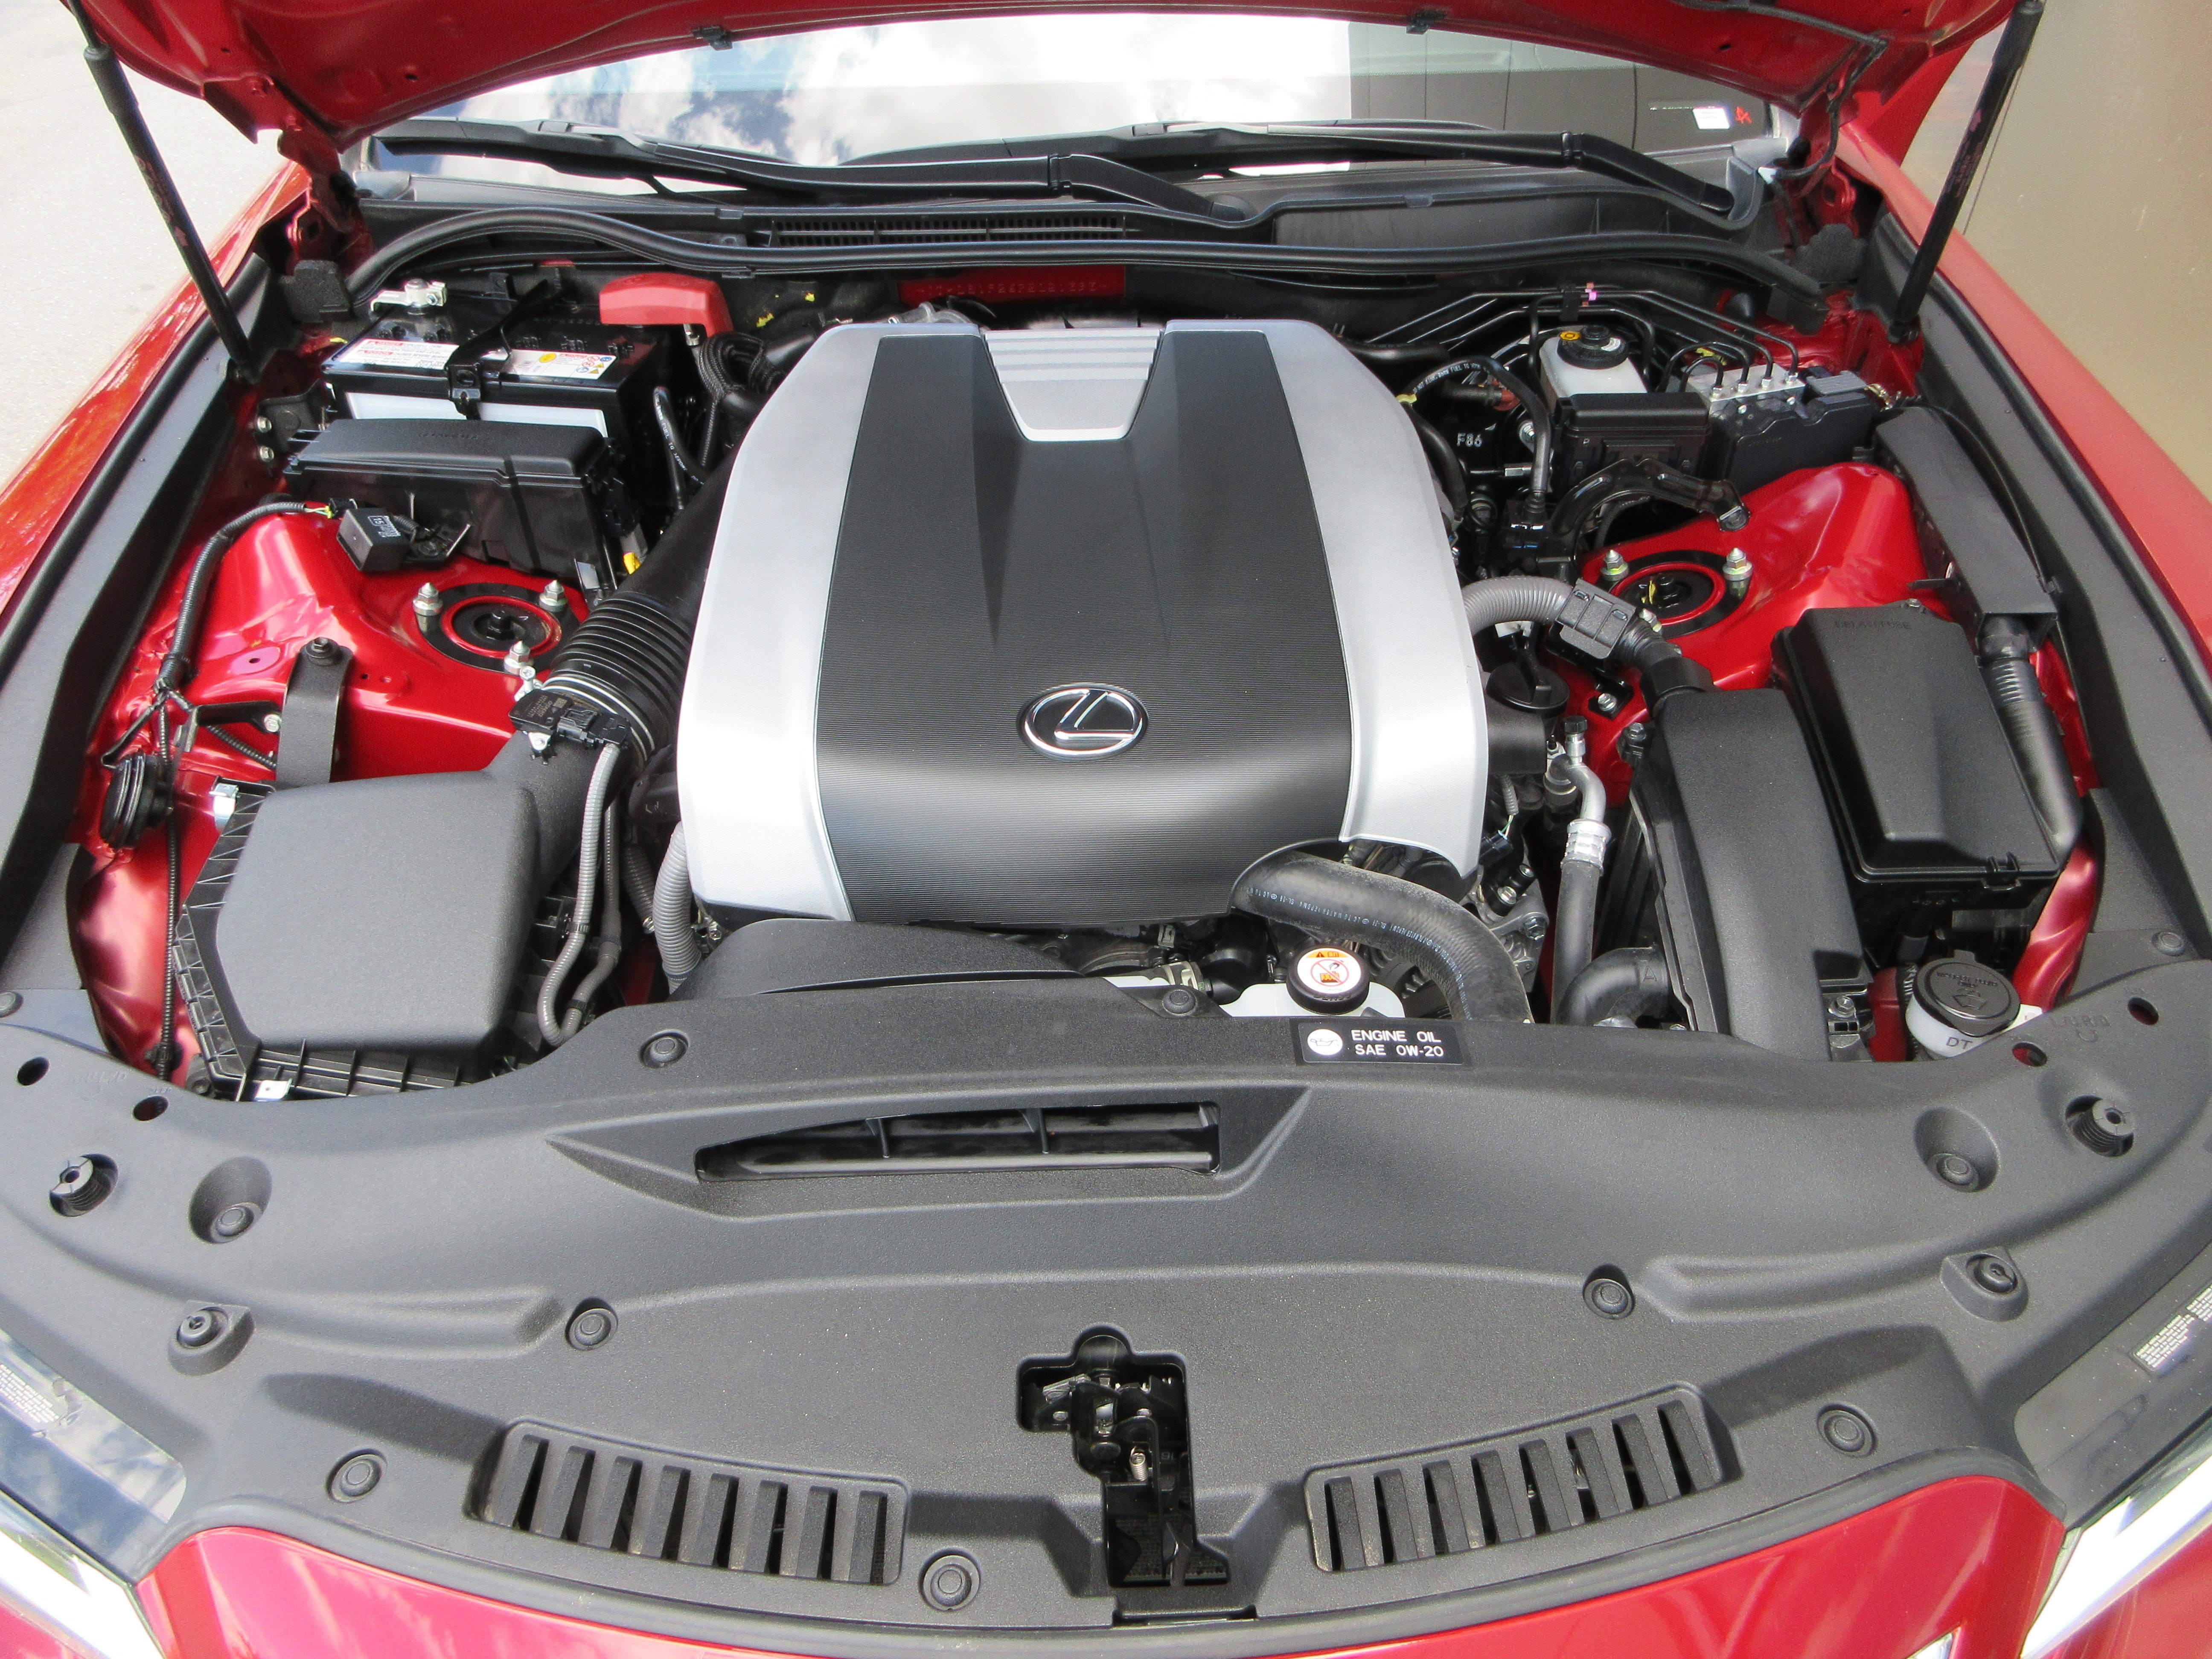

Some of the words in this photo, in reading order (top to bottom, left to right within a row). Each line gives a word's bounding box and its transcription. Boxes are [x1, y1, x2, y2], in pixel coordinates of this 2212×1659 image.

[1450, 365, 1462, 373] FUEL
[1457, 433, 1482, 448] F86
[1323, 908, 1342, 919] WATER
[1351, 1029, 1407, 1042] ENGINE
[1416, 1030, 1441, 1043] OIL
[1946, 1036, 1973, 1049] DT
[1355, 1044, 1386, 1055] SAE
[1396, 1045, 1444, 1057] 0W-20
